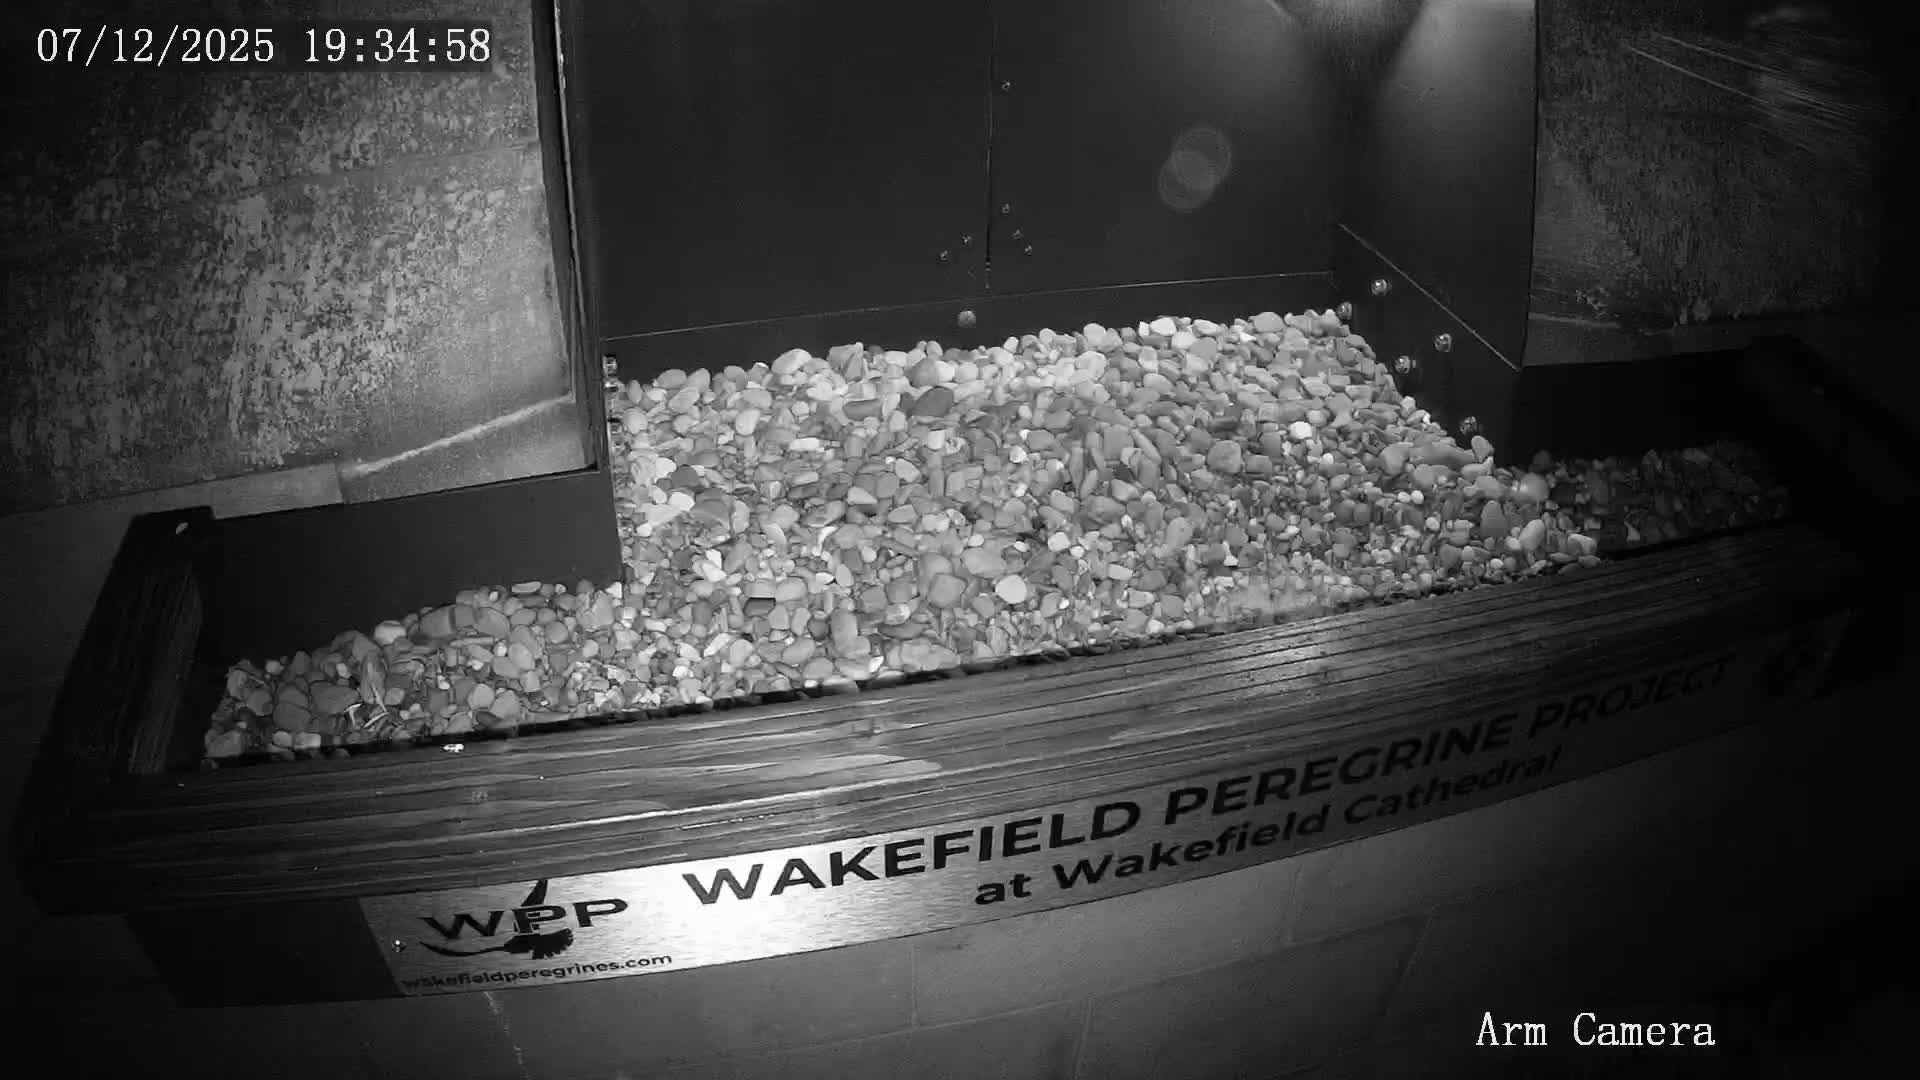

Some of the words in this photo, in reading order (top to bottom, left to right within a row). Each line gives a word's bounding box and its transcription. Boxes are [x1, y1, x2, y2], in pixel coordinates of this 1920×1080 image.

[682, 801, 1142, 905] WAKEFIELD
[1163, 714, 1517, 825] PEREGRINE
[1528, 656, 1734, 740] PROJECT
[975, 873, 1031, 905] at
[1052, 803, 1331, 890] Wakefield
[1343, 748, 1562, 823] Cathedral
[417, 897, 629, 941] WPP
[401, 953, 673, 988] wakefieldperegrines.com
